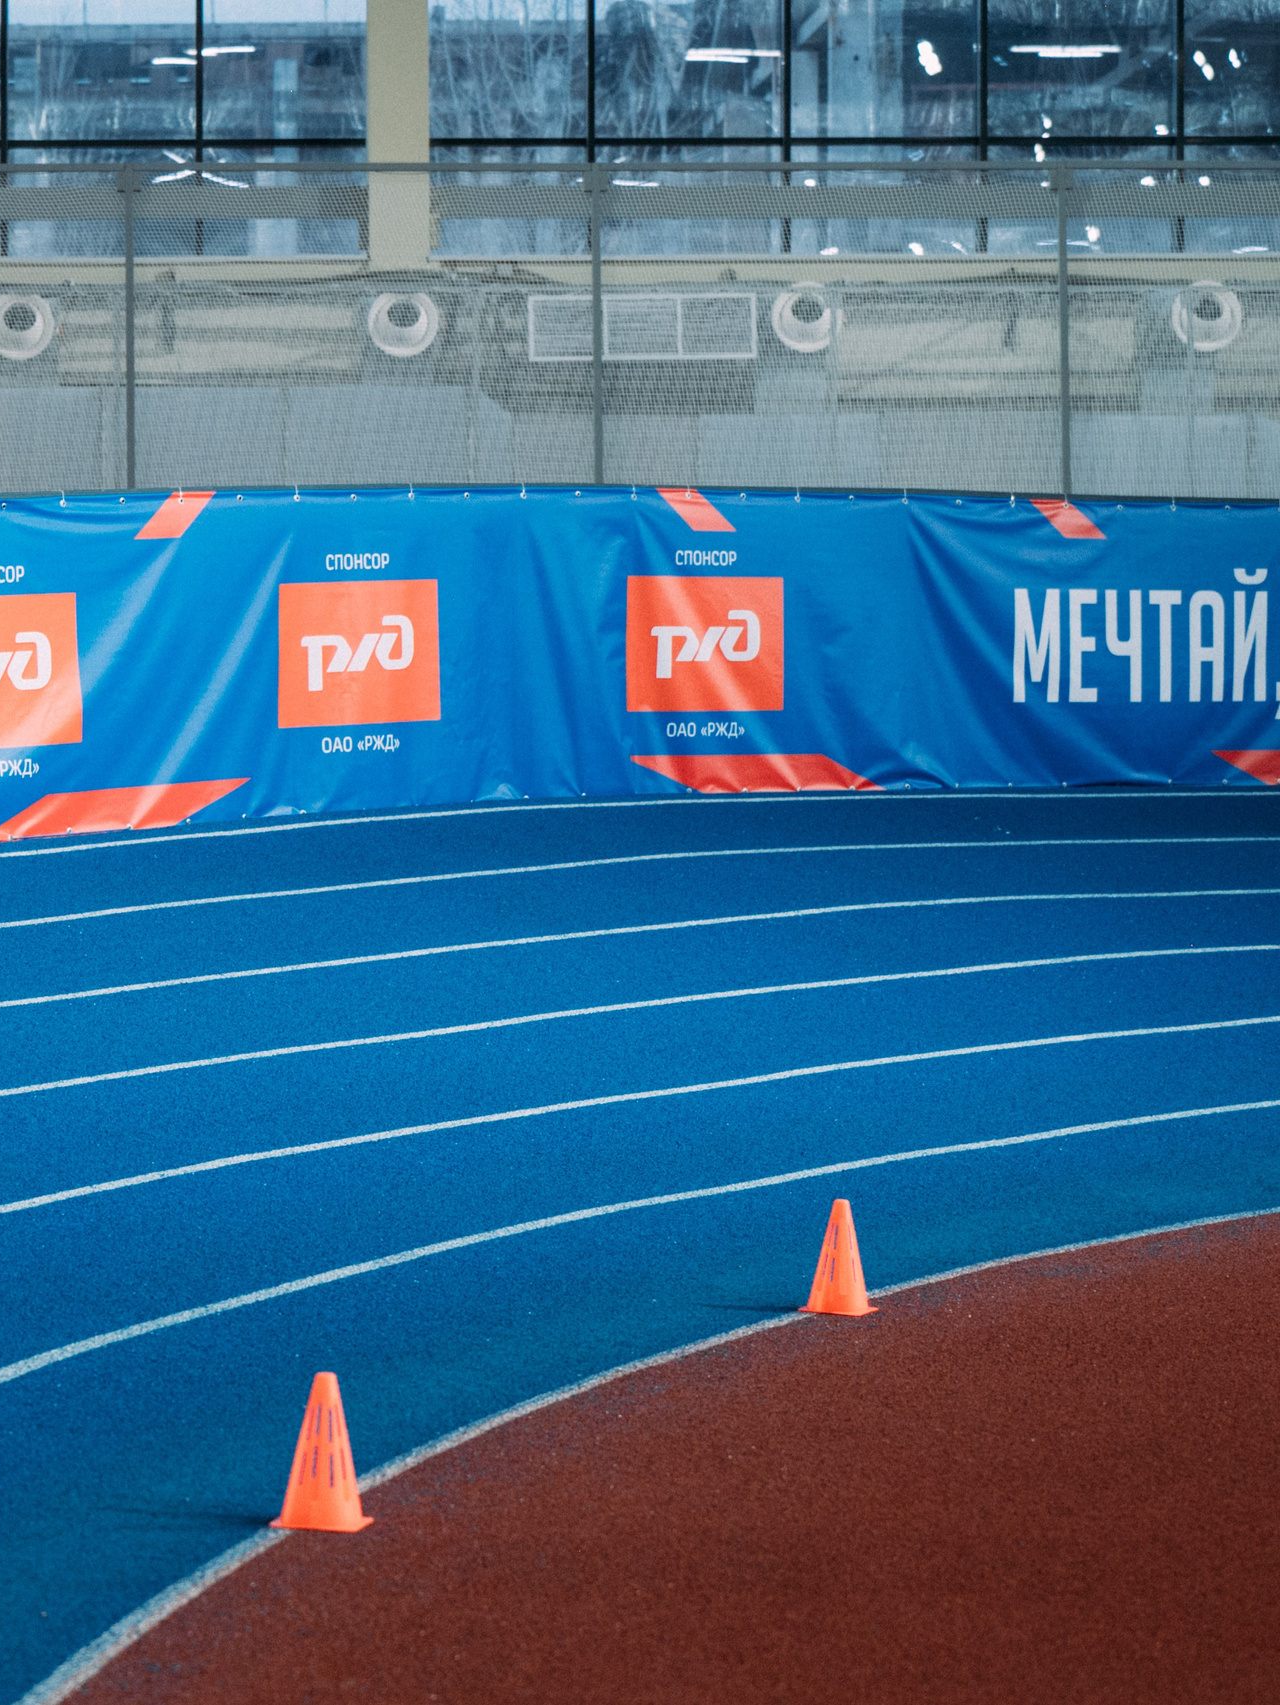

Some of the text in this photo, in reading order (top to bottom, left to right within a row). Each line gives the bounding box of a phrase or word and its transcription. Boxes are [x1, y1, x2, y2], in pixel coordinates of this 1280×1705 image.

[325, 552, 391, 571] СПОНСОР
[675, 549, 738, 567] СПОНСОР
[666, 721, 746, 740] ОАО «РЖД»
[321, 734, 401, 754] ОАО «РЖД»
